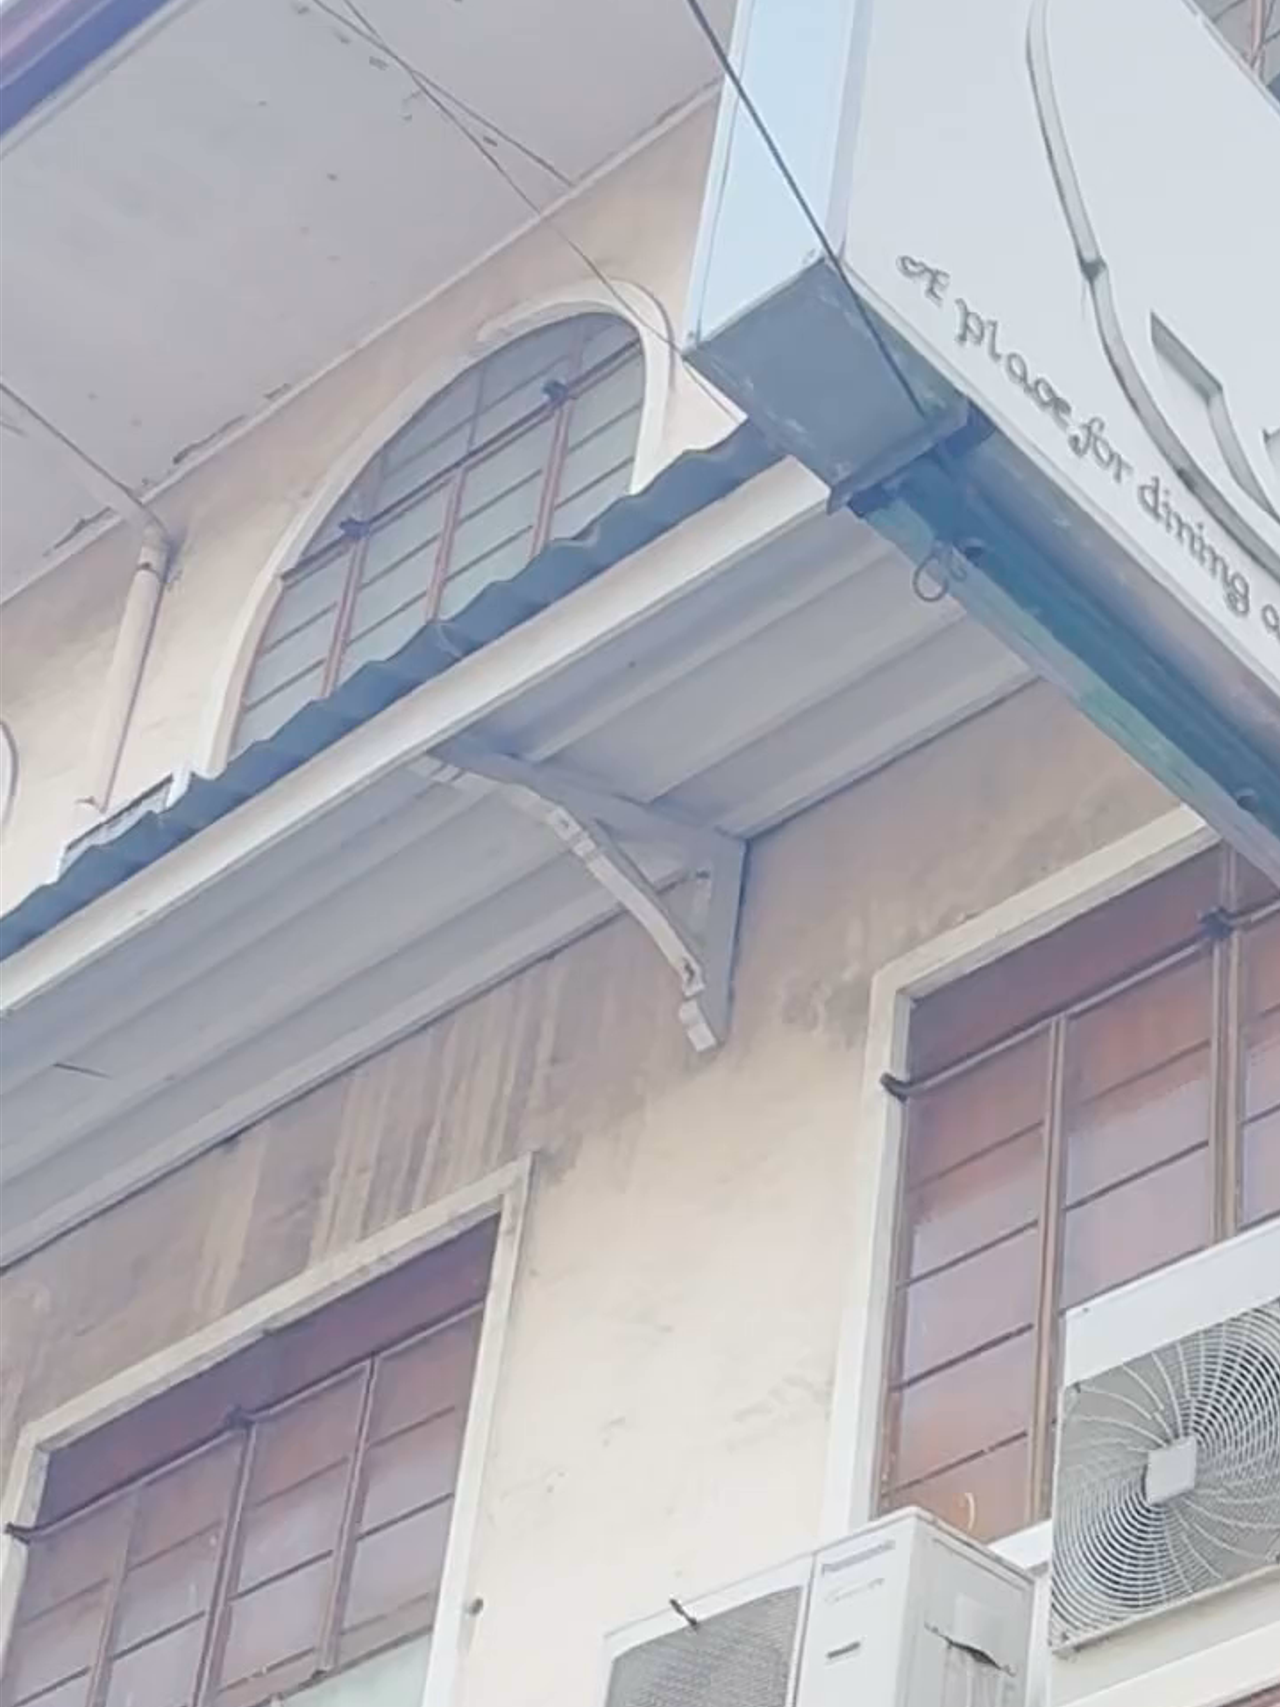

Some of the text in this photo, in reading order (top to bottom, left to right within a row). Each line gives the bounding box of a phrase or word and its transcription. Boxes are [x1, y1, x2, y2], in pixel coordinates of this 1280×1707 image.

[954, 297, 1074, 429] place
[1068, 416, 1134, 484] for
[1137, 476, 1250, 617] dining
